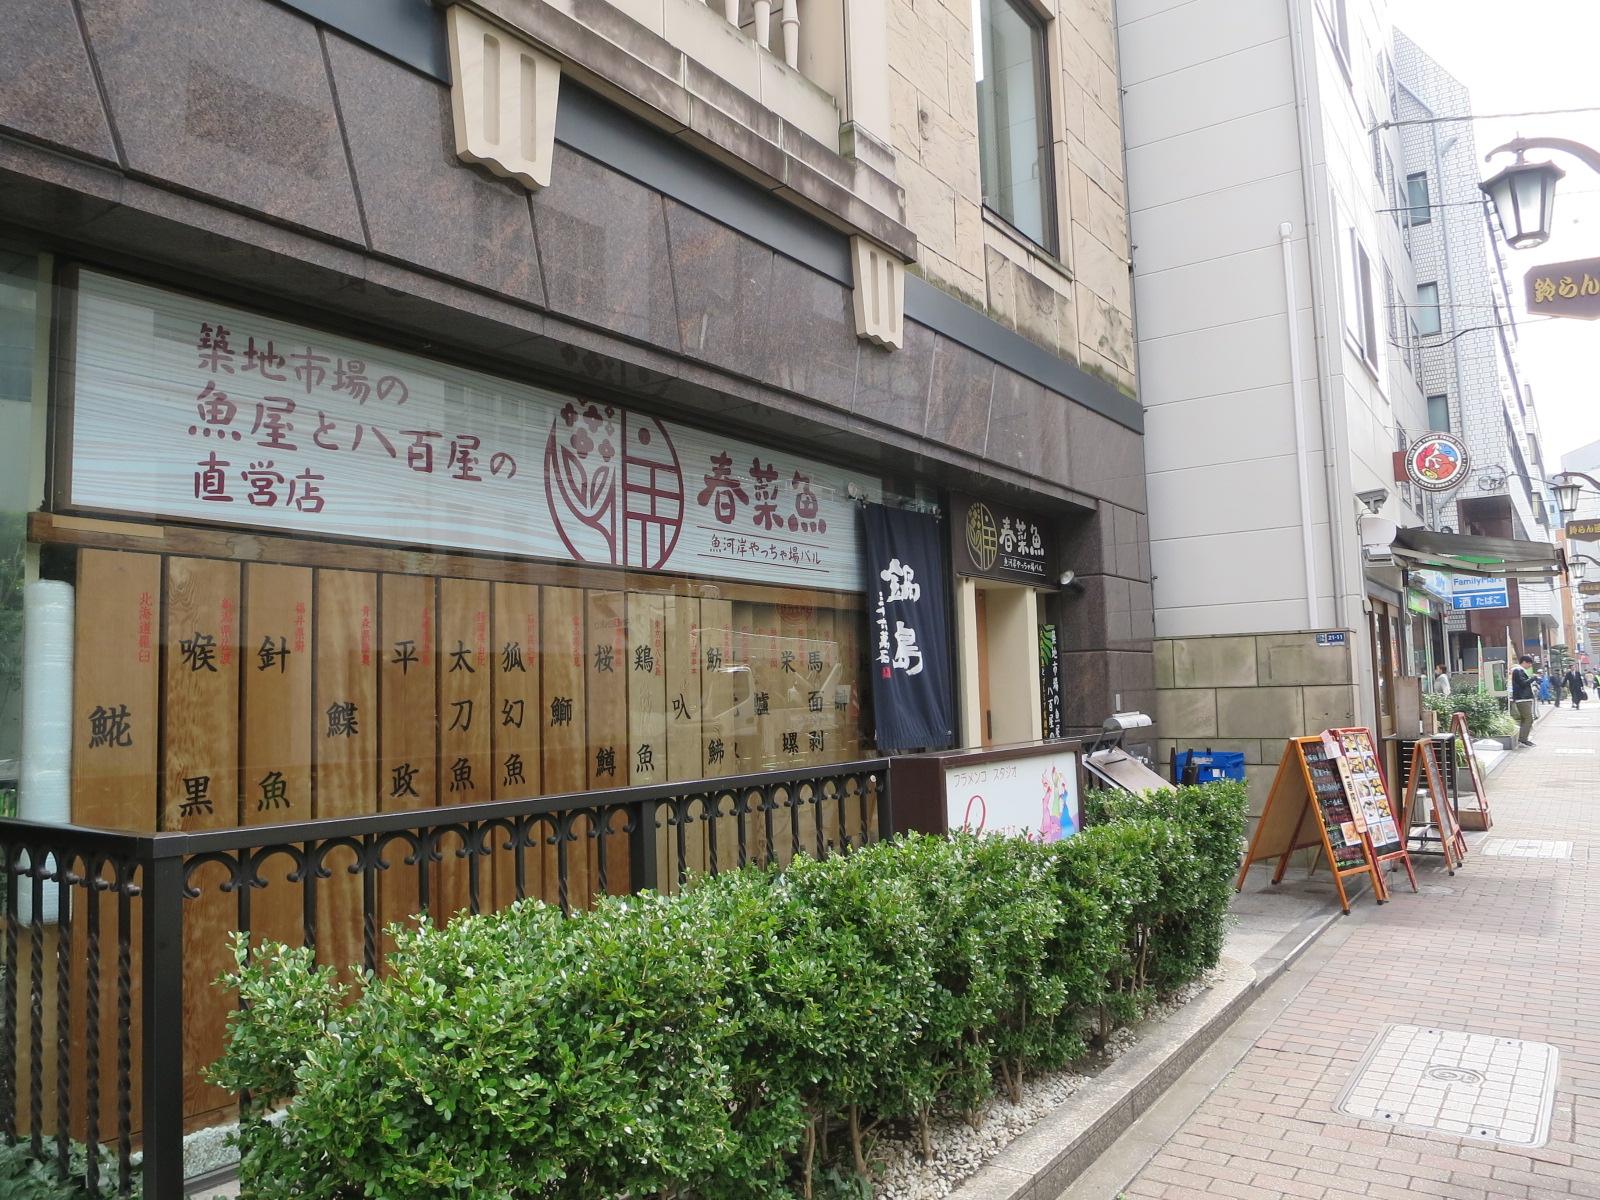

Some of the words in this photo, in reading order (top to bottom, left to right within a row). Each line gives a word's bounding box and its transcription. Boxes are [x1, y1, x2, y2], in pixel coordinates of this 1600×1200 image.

[1535, 274, 1600, 303] 鈴らん
[197, 322, 409, 406] 築地市場の
[188, 381, 517, 482] 魚屋と八百屋の
[194, 451, 325, 514] 直営店
[697, 451, 827, 534] 春菜魚
[710, 534, 821, 565] 魚河岸やっちゃ場バル
[999, 517, 1045, 556] 春菜魚
[881, 559, 924, 676] 鍋島
[1459, 597, 1472, 608] 酒
[1475, 596, 1502, 606] たばこ
[257, 635, 291, 812] 針魚
[390, 639, 420, 798] 平政
[448, 640, 475, 792] 太刀魚
[634, 644, 655, 773] 鶏魚
[781, 650, 799, 756] 栄螺
[807, 650, 824, 752] 馬面剥
[954, 770, 987, 788] フラメンコ
[993, 766, 1017, 780] スタジオ
